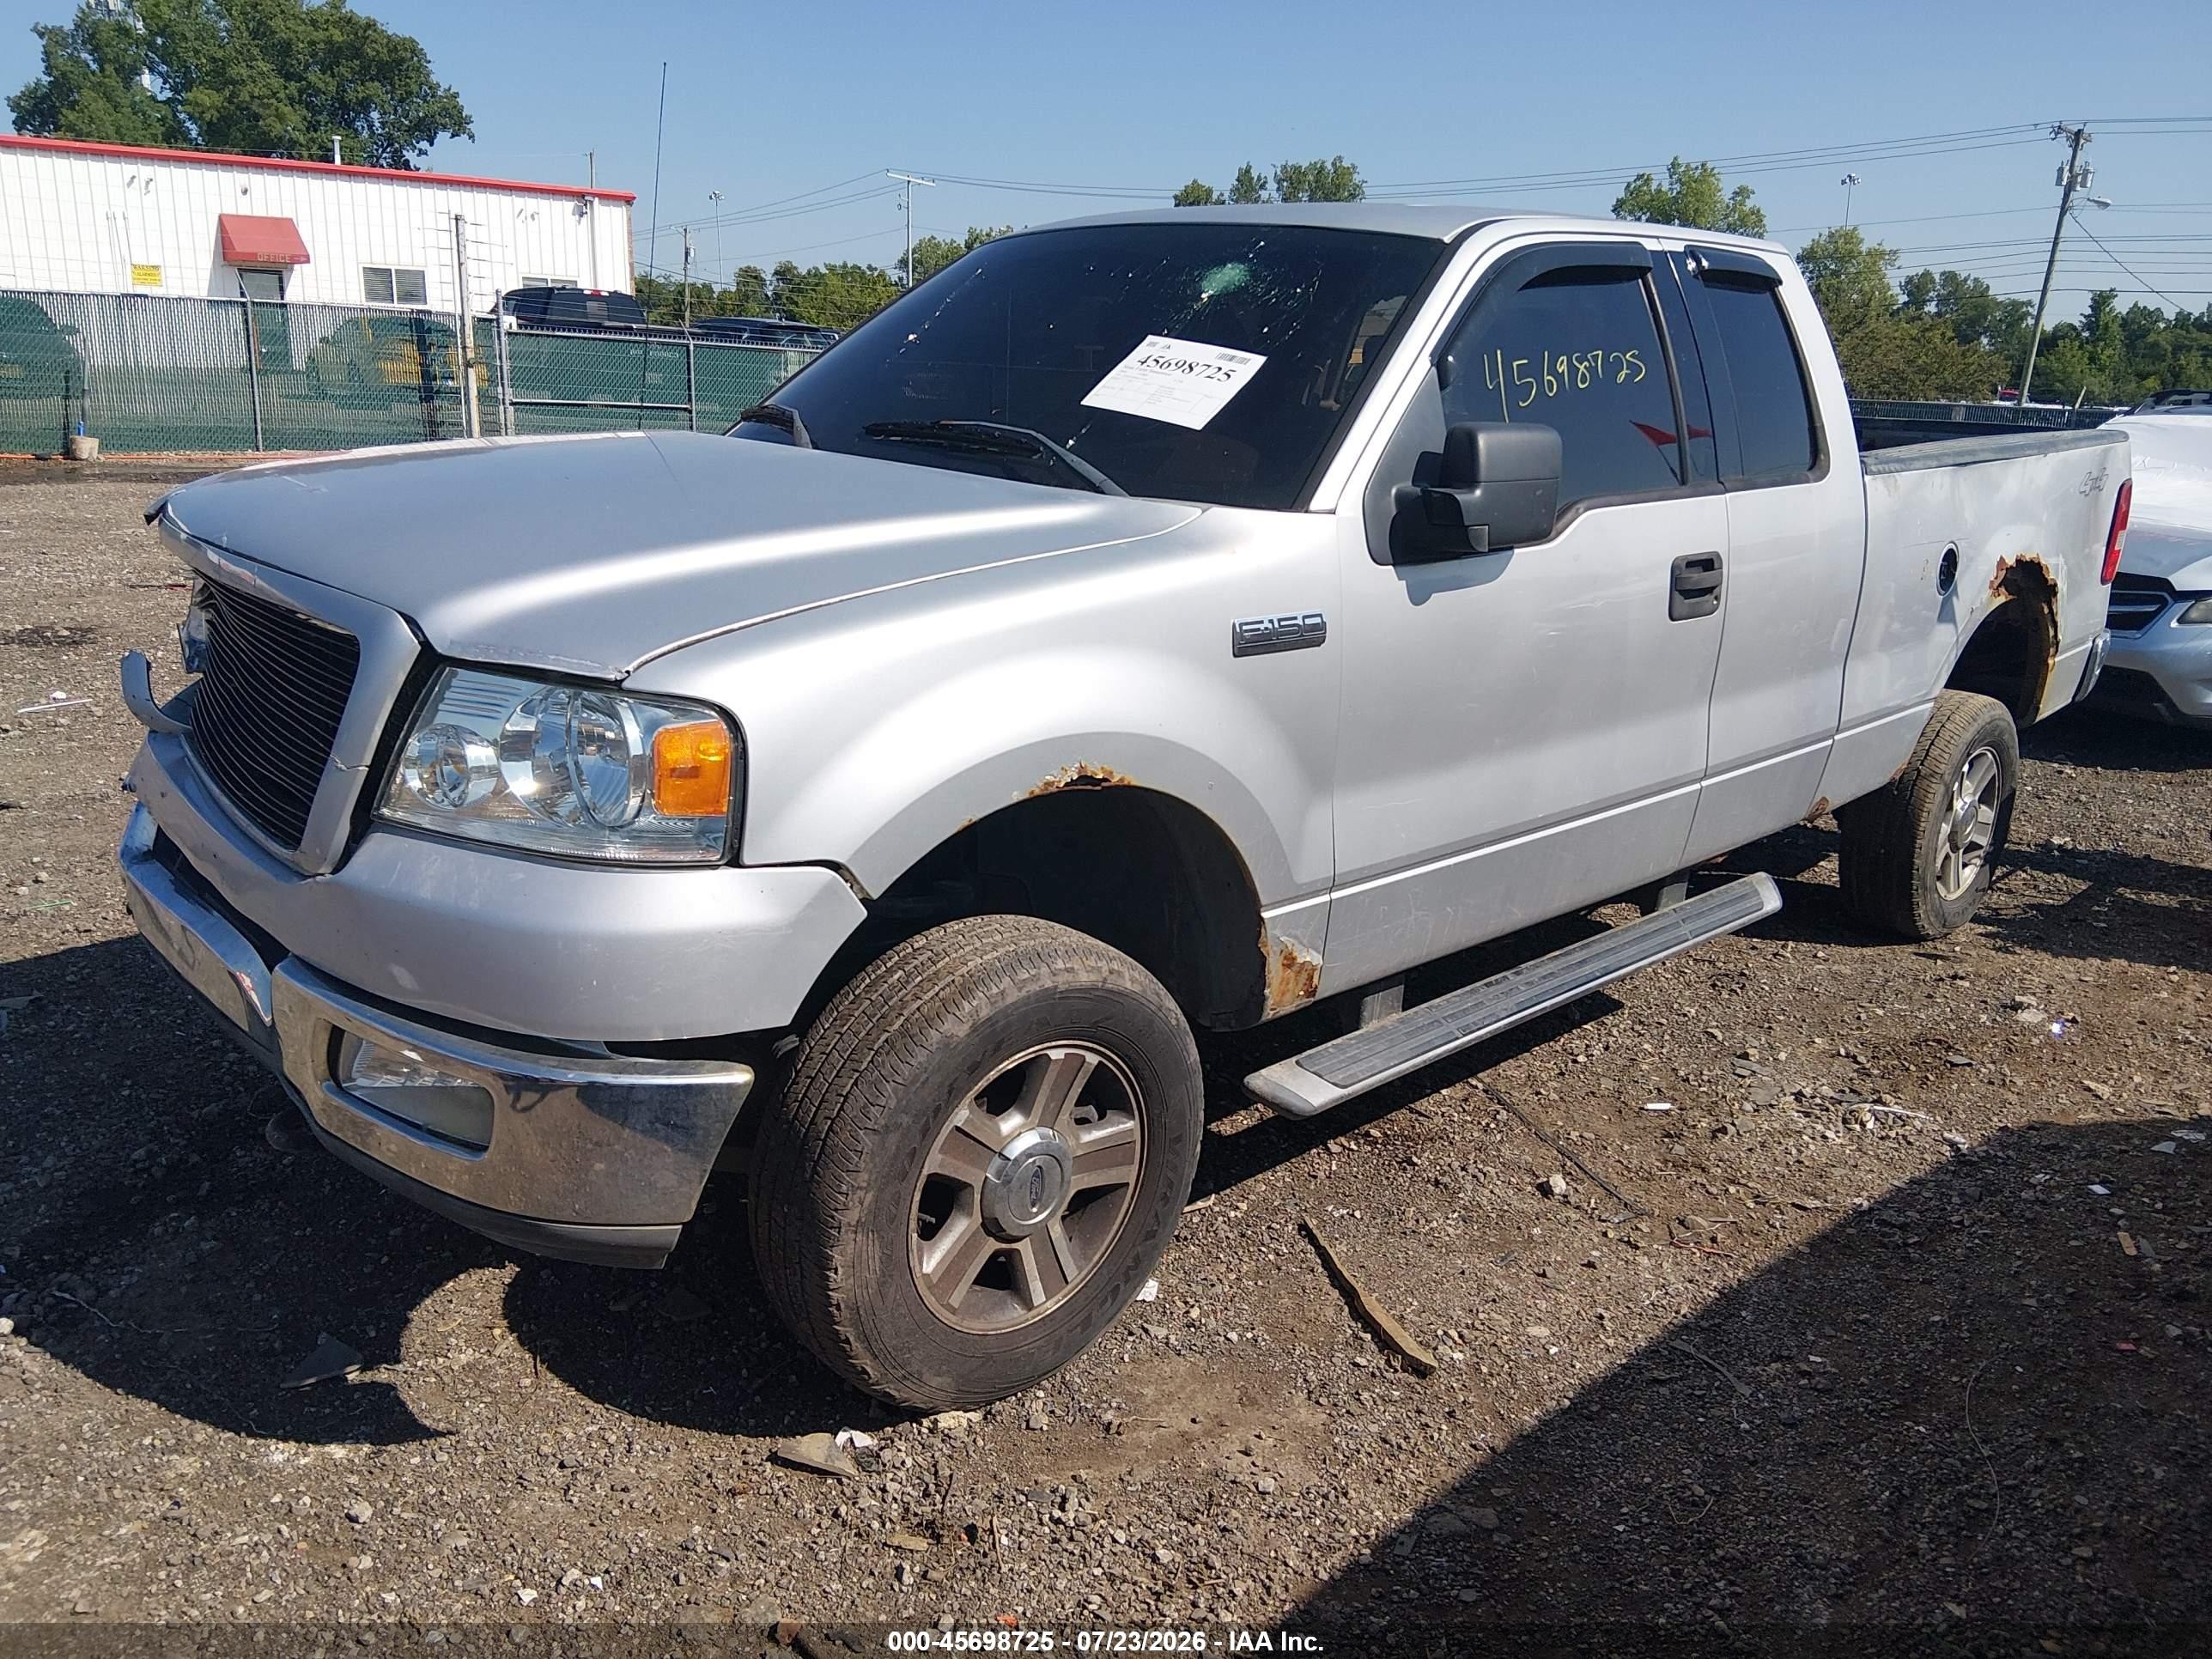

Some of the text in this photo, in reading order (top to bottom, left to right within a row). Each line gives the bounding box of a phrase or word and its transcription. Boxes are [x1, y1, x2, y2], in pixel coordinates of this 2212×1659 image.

[257, 252, 292, 263] OFFICE
[1138, 355, 1237, 382] 45698725
[1483, 349, 1646, 423] 45698725
[1238, 612, 1327, 645] F-150
[1030, 1176, 1042, 1201] Ford
